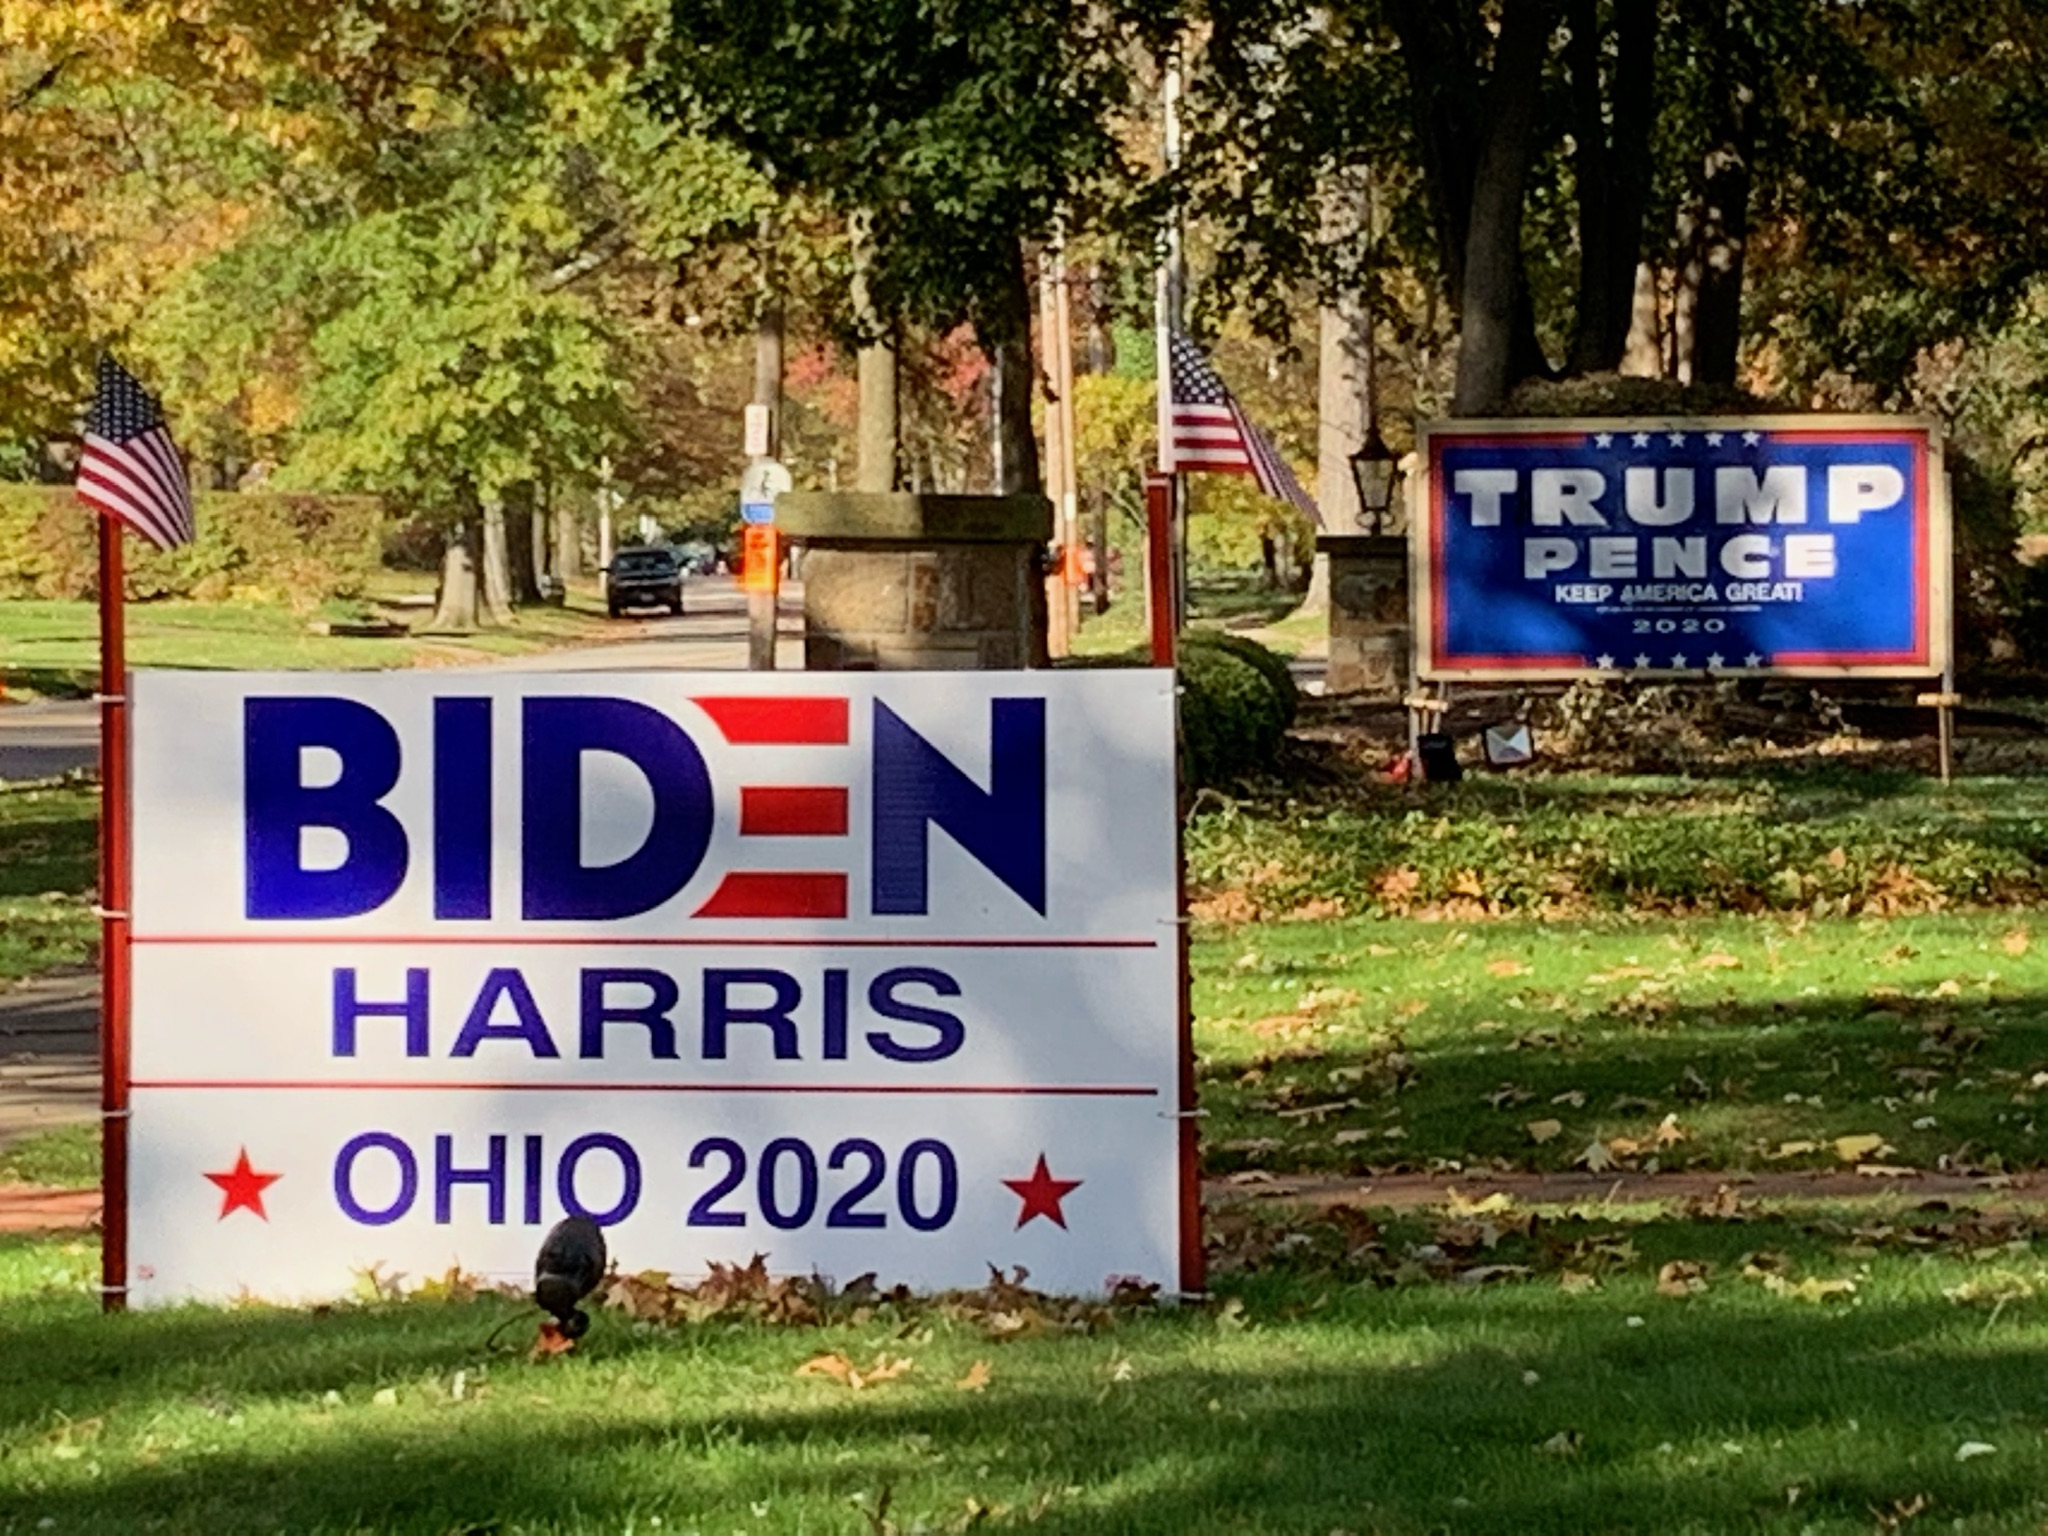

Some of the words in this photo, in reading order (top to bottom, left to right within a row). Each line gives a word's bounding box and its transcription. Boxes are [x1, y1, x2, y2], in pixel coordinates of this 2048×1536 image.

[1454, 465, 1904, 527] TRUMP
[1524, 534, 1836, 579] PENCE
[1555, 584, 1613, 603] KEEP
[1621, 583, 1717, 604] AMERICA
[1632, 618, 1726, 634] 2020
[244, 696, 1046, 921] BIDEN
[333, 967, 964, 1062] HARRIS
[334, 1132, 641, 1227] OHIO
[688, 1138, 957, 1231] 2020
